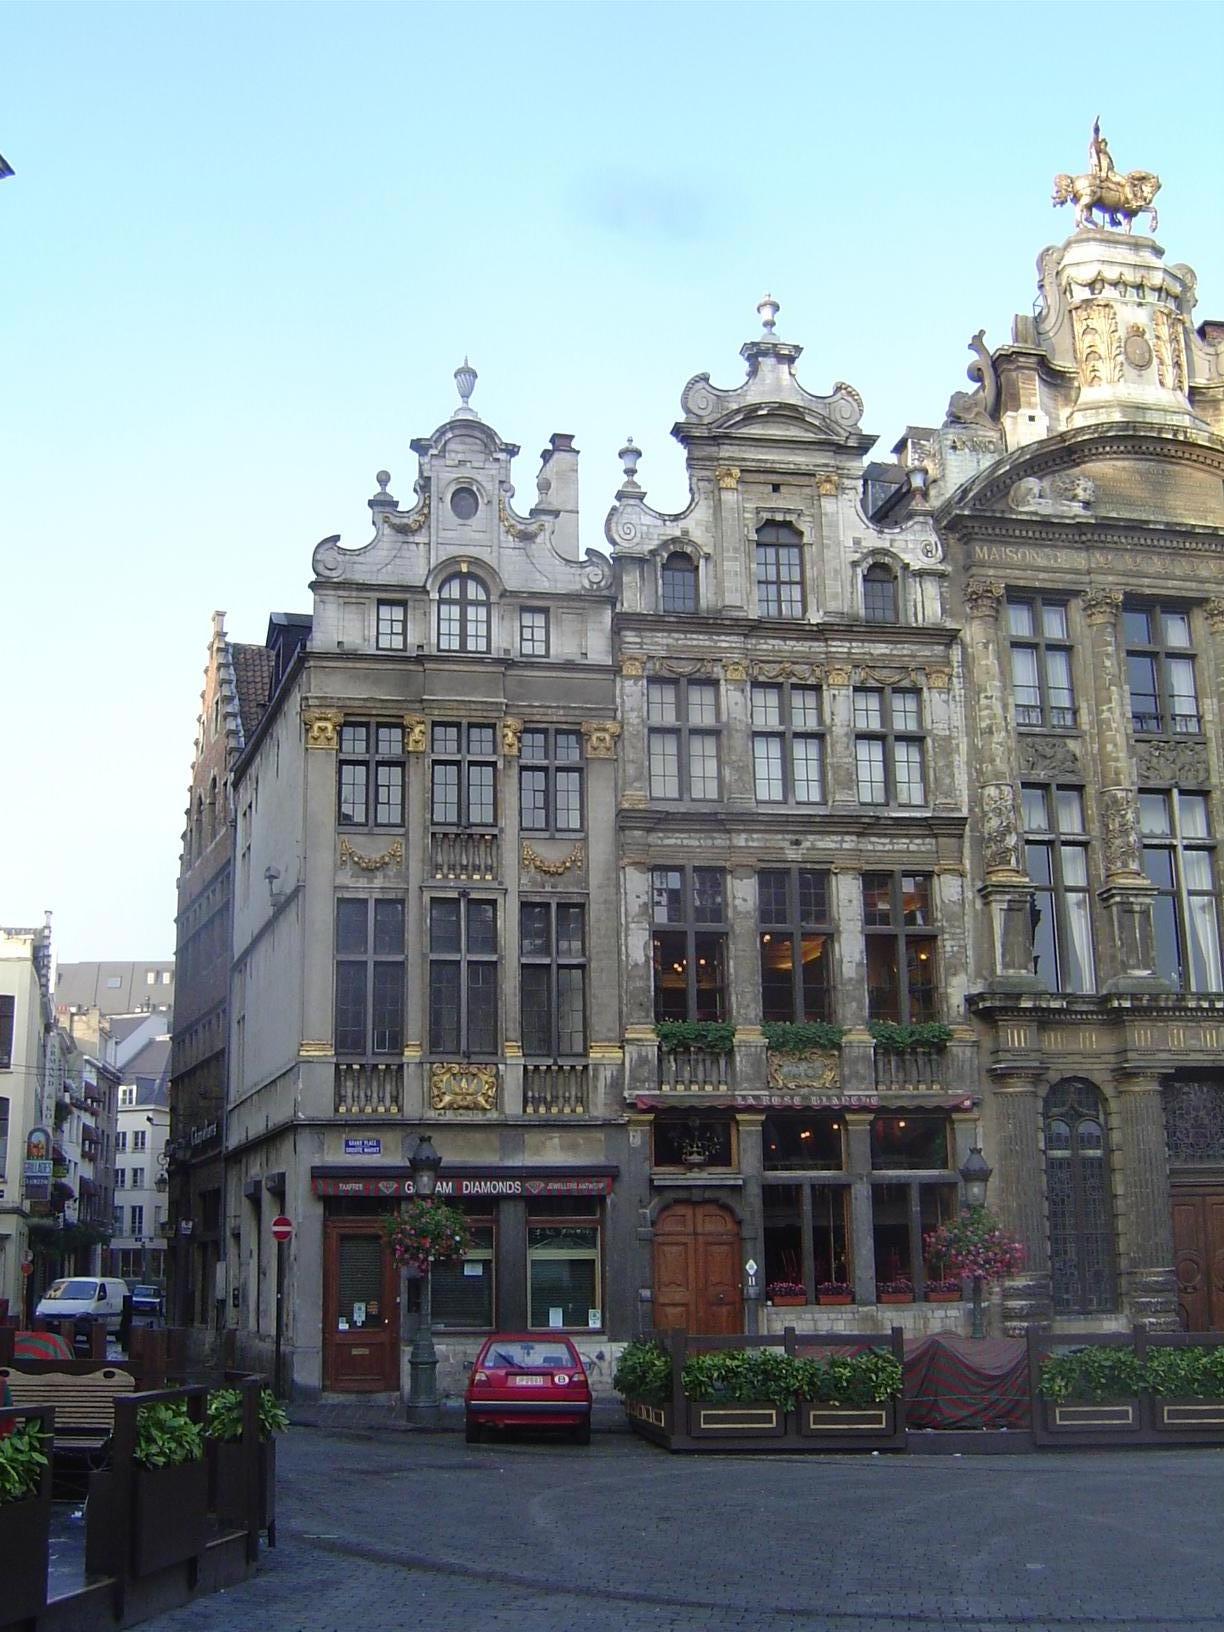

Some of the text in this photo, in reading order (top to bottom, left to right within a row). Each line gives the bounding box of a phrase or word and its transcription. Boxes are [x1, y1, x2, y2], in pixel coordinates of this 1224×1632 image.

[975, 546, 1042, 563] MAISON
[736, 1095, 879, 1105] LA ROSE BLANCHE
[462, 1181, 521, 1194] DIAMONDS
[748, 1276, 755, 1286] 11
